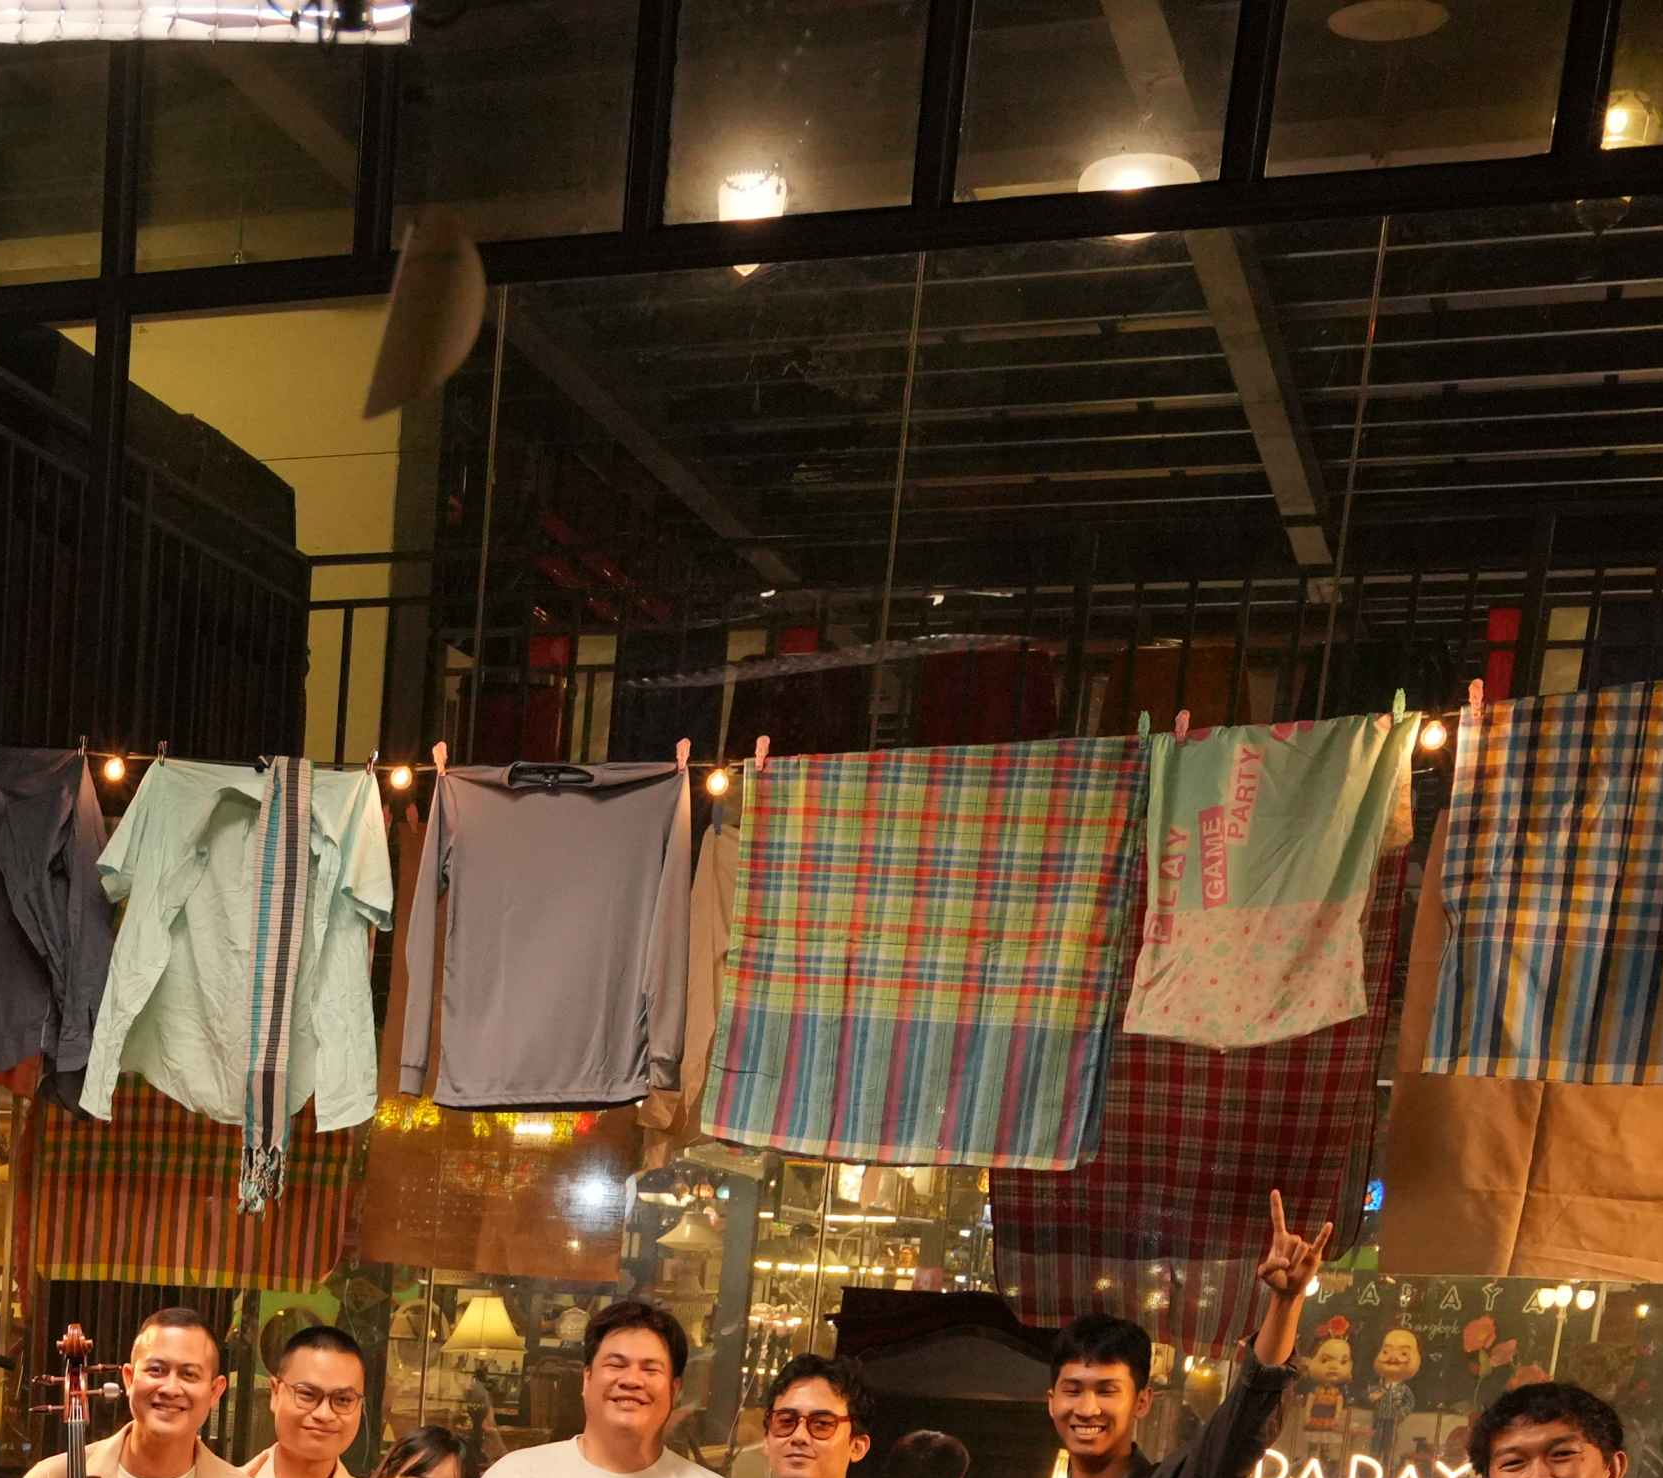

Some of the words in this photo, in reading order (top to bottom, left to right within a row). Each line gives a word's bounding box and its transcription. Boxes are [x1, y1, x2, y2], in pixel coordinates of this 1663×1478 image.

[1226, 747, 1262, 841] PARTY
[1147, 828, 1185, 941] PLAY
[1200, 814, 1224, 901] GAME
